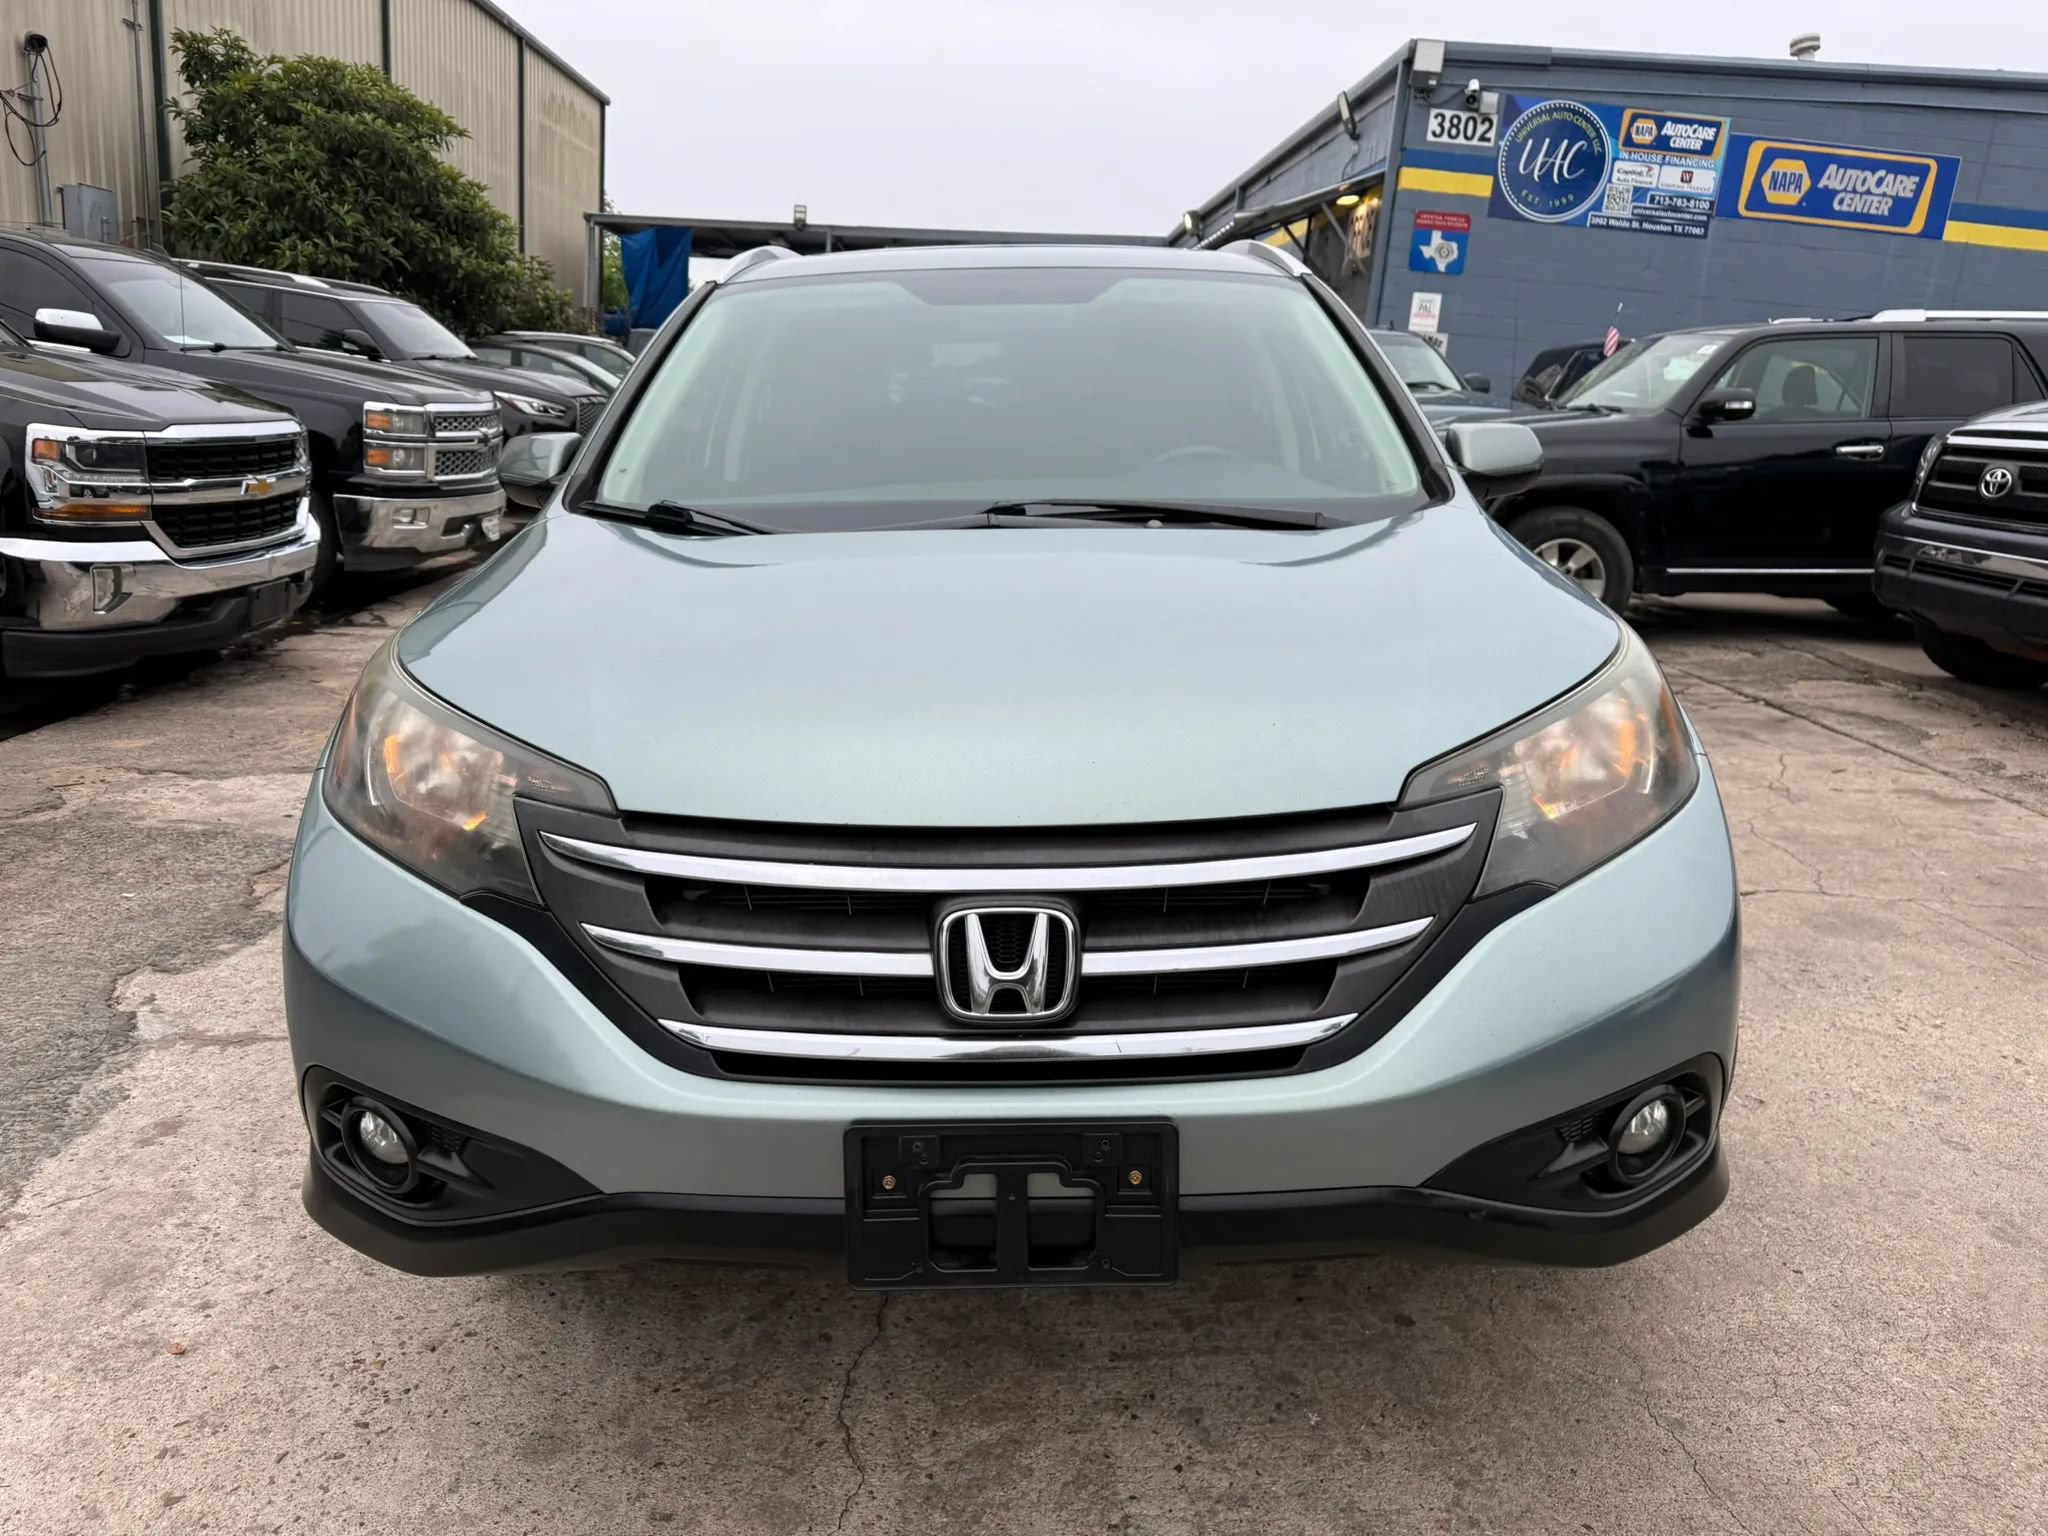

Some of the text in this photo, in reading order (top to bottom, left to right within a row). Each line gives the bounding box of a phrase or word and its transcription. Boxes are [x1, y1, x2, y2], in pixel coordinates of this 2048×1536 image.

[1431, 112, 1494, 143] 3802
[1515, 111, 1603, 156] UNIVERSAL AUTO CENTER LLC
[1635, 124, 1654, 137] NAPA
[1669, 137, 1703, 150] CENTER
[1519, 137, 1587, 184] UAC
[1619, 151, 1715, 168] IN HOUSE FINANCING
[1769, 170, 1803, 194] NAPA
[1832, 191, 1893, 216] CENTER
[1642, 221, 1672, 232] Houston
[1673, 225, 1683, 233] TX
